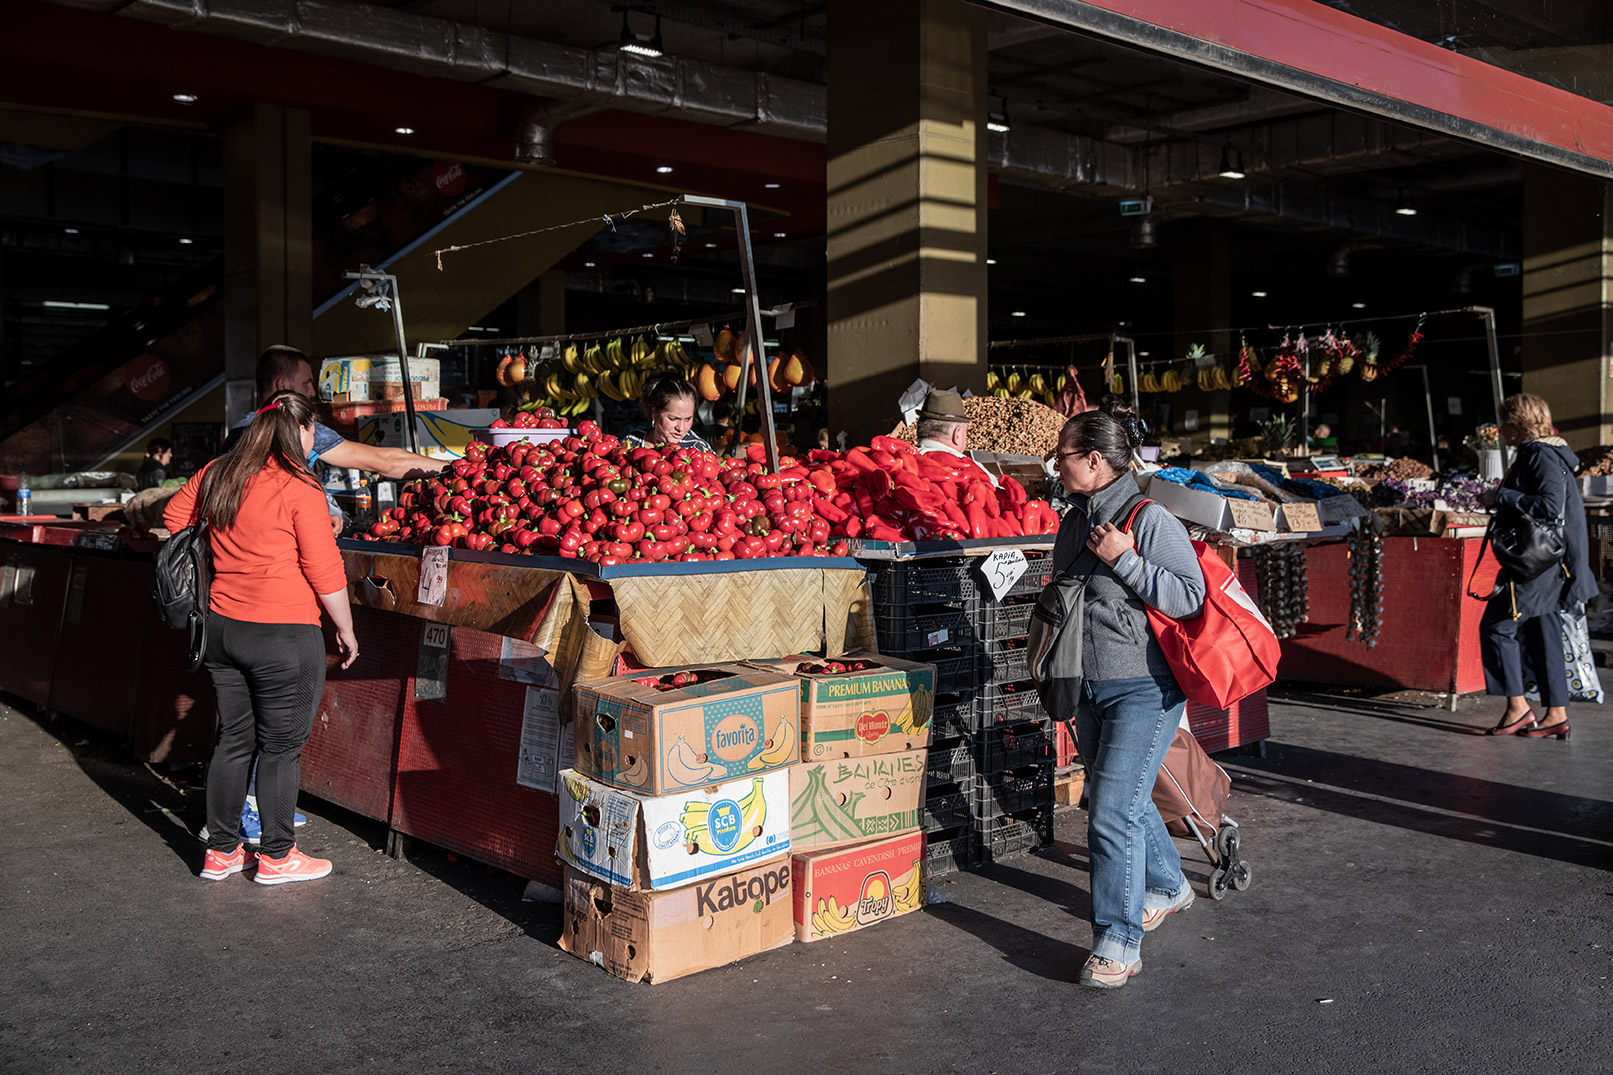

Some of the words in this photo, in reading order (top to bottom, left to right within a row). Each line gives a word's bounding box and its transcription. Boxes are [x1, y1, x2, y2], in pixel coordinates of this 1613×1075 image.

[993, 560, 1007, 589] 5
[426, 627, 446, 644] 470
[828, 681, 871, 697] PREMIUM
[872, 677, 912, 693] BANANAS
[858, 722, 868, 732] Del
[868, 720, 888, 731] Monte
[716, 726, 755, 749] favorita
[833, 755, 925, 784] BANANES
[715, 814, 736, 830] SCB
[814, 861, 851, 878] BANANAS
[853, 849, 895, 868] CAVENDISH
[696, 865, 790, 918] Katope
[860, 894, 890, 916] Tropy
